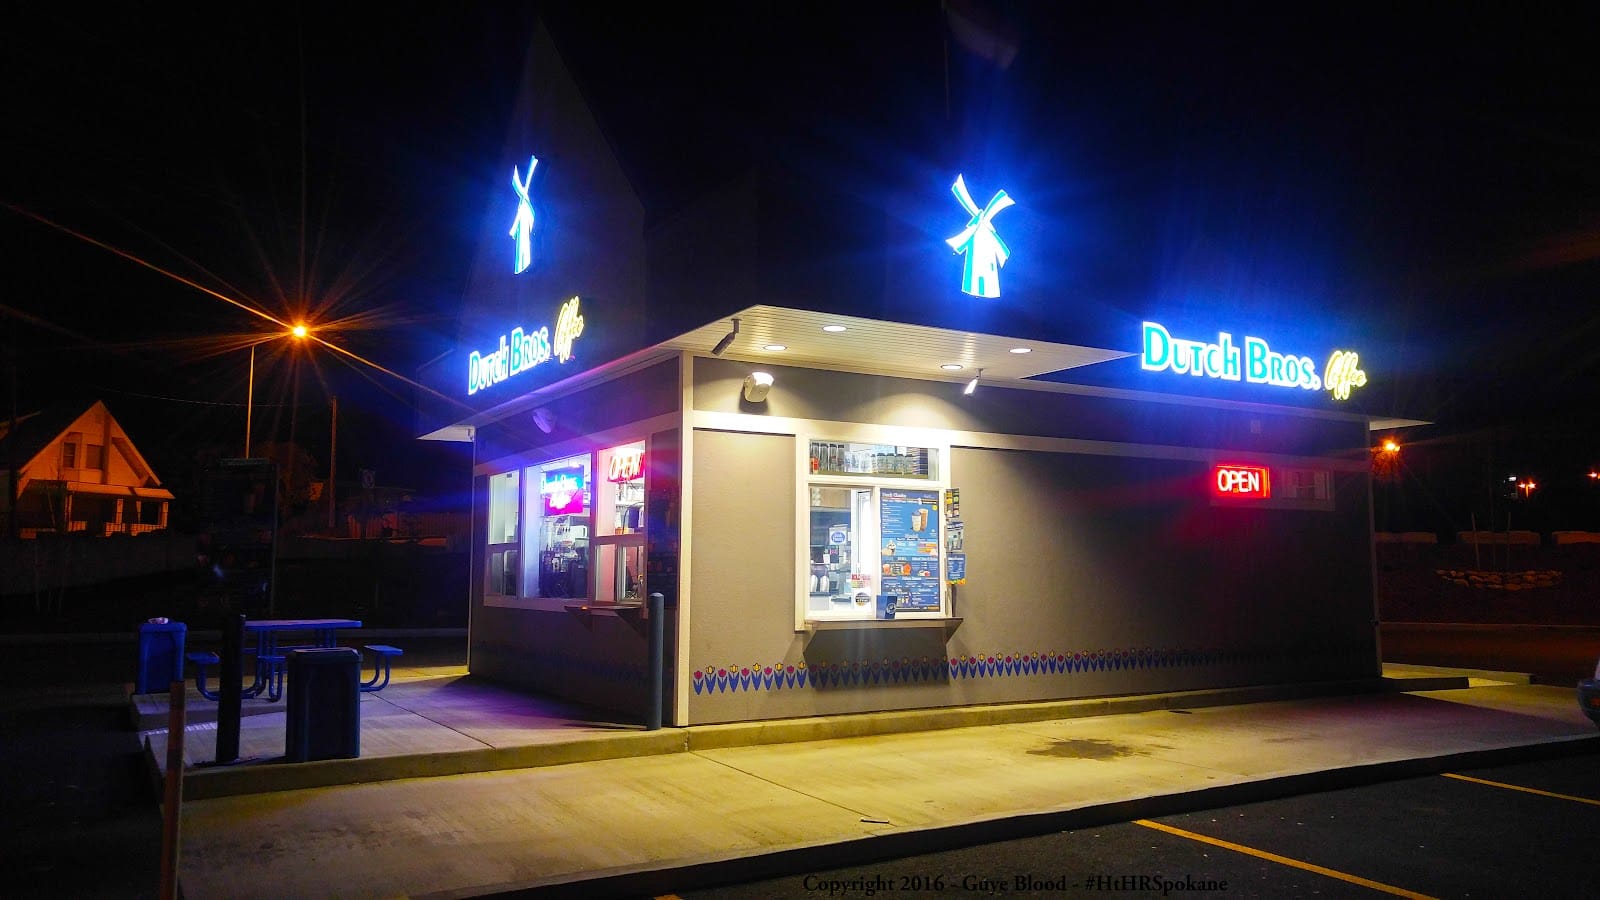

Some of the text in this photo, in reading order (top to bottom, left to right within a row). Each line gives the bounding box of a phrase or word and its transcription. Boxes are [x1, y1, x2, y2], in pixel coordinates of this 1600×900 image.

[1324, 350, 1368, 401] Coffee
[608, 452, 642, 480] OPEN
[1217, 469, 1260, 493] OPEN
